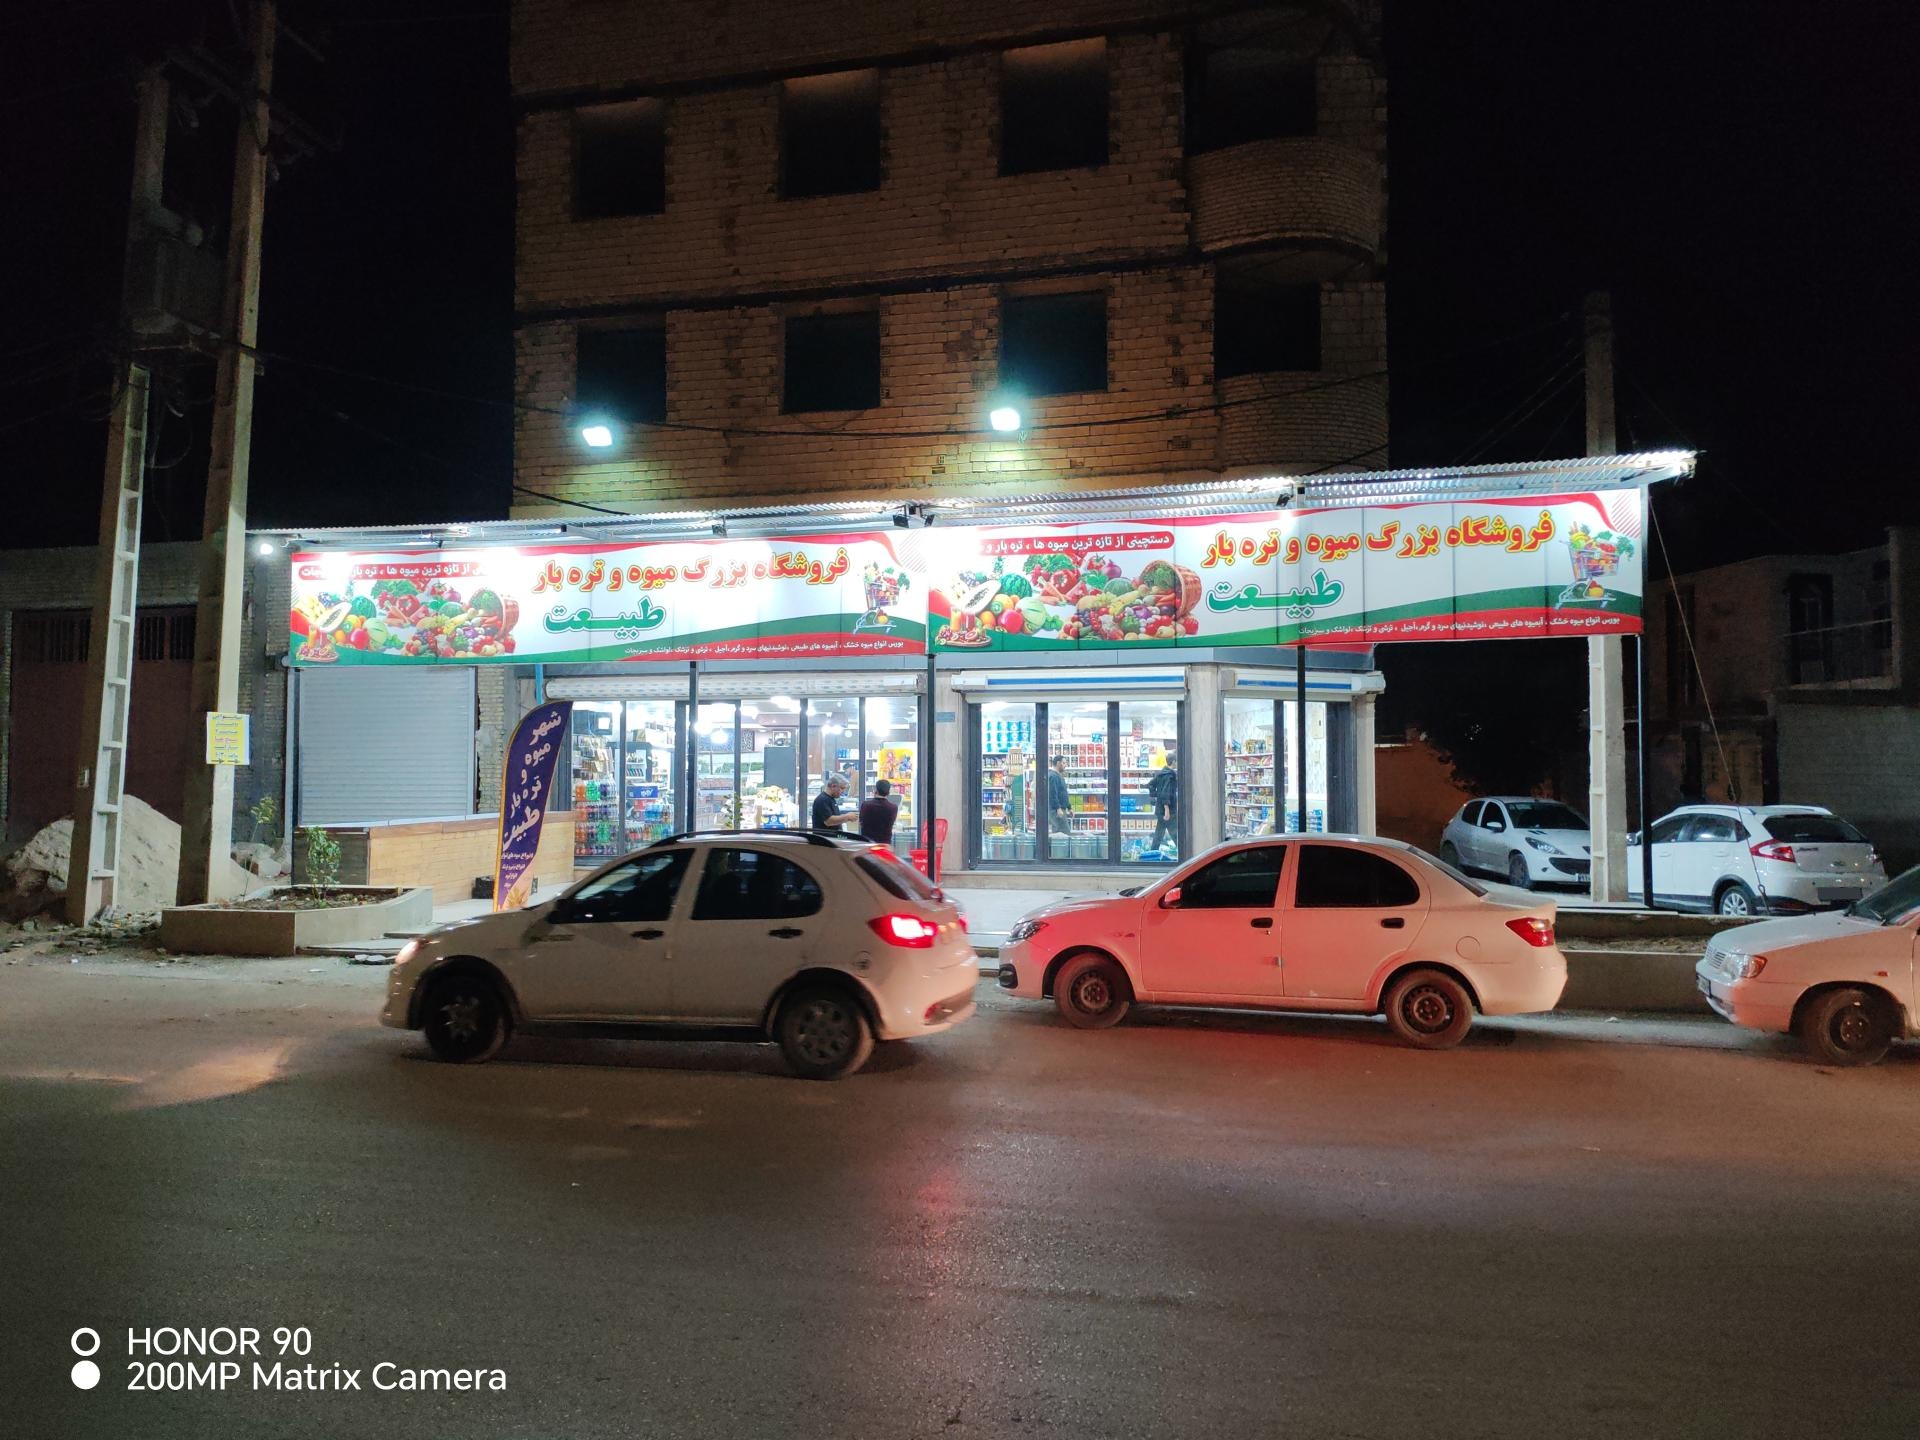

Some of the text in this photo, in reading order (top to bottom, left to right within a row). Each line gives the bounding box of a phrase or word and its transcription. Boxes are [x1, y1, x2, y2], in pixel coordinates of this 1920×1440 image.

[1034, 539, 1044, 549] ها
[1072, 537, 1093, 550] ترین
[1095, 536, 1112, 548] تازه
[1115, 535, 1124, 548] از
[1201, 510, 1555, 568] فروشگاه بزرگ میوه و تره بار
[996, 541, 1008, 552] بار
[1010, 541, 1023, 552] تره
[1048, 541, 1068, 552] میوه
[365, 567, 377, 577] تره
[386, 566, 396, 575] ها
[399, 569, 419, 579] میوه
[422, 566, 441, 578] ترین
[444, 565, 459, 576] تازه
[461, 563, 470, 575] از
[532, 547, 850, 594] فروشگاه بزرگ میوه و تره بار
[1206, 568, 1344, 618] طبیعت
[543, 595, 666, 639] طبیعت
[1550, 617, 1568, 625] خشک
[1569, 619, 1584, 627] میوه
[1585, 617, 1600, 627] انواع
[1510, 619, 1523, 628] های
[529, 710, 562, 746] شهر
[525, 742, 551, 767] میوه
[521, 769, 528, 785] و
[503, 806, 540, 851] طبیعت
